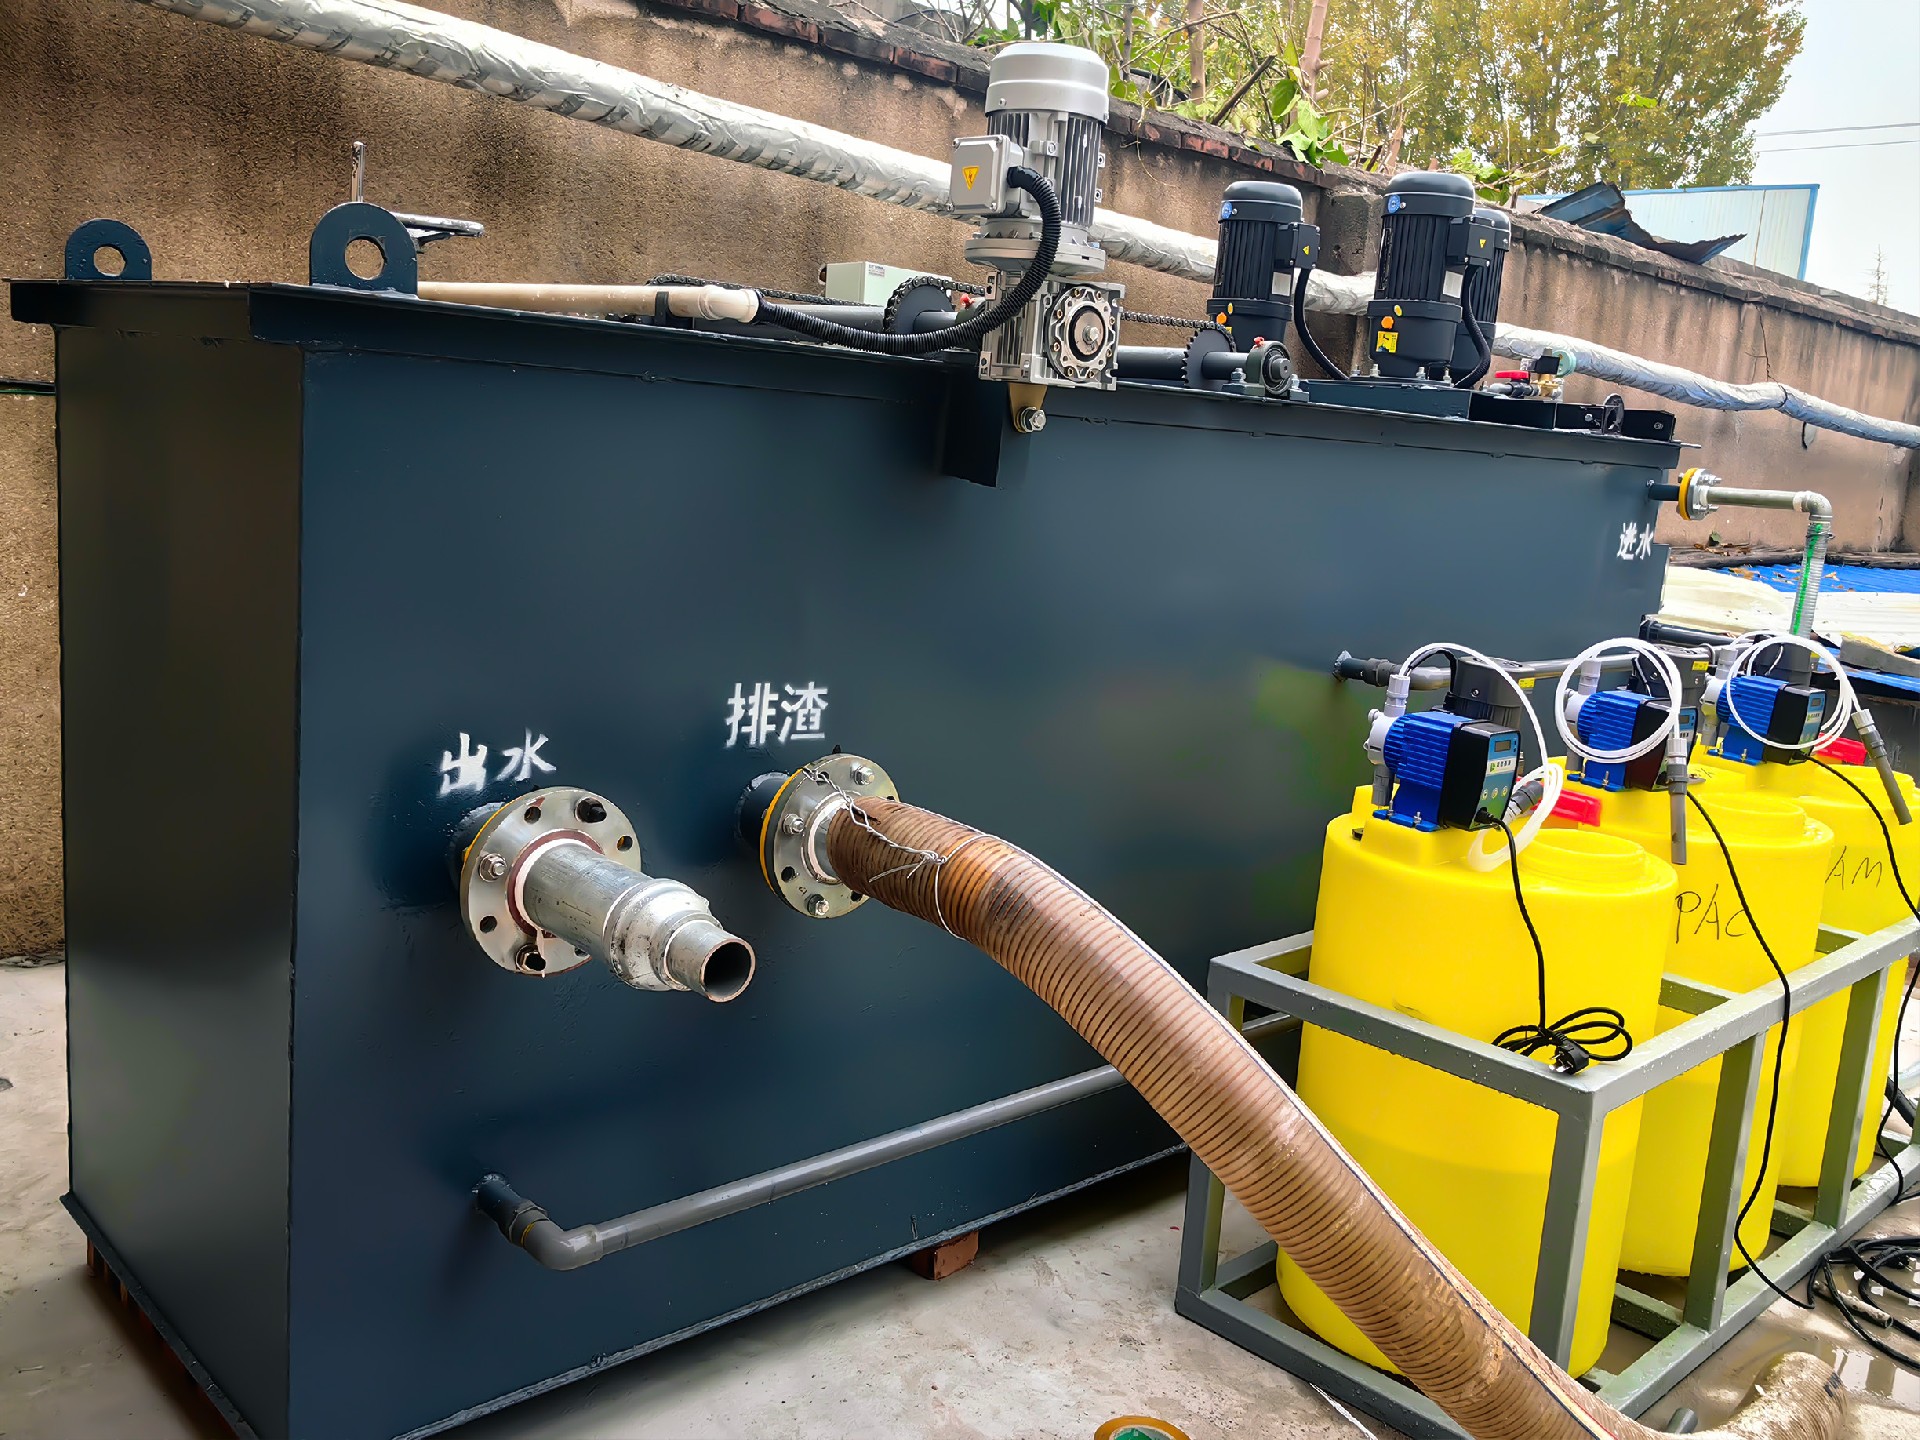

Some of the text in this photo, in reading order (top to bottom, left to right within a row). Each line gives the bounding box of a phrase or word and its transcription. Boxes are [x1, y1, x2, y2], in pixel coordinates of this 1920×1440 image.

[1617, 522, 1654, 560] 进水
[726, 681, 829, 748] 排渣
[440, 728, 557, 796] 出水
[1675, 883, 1748, 944] PAC
